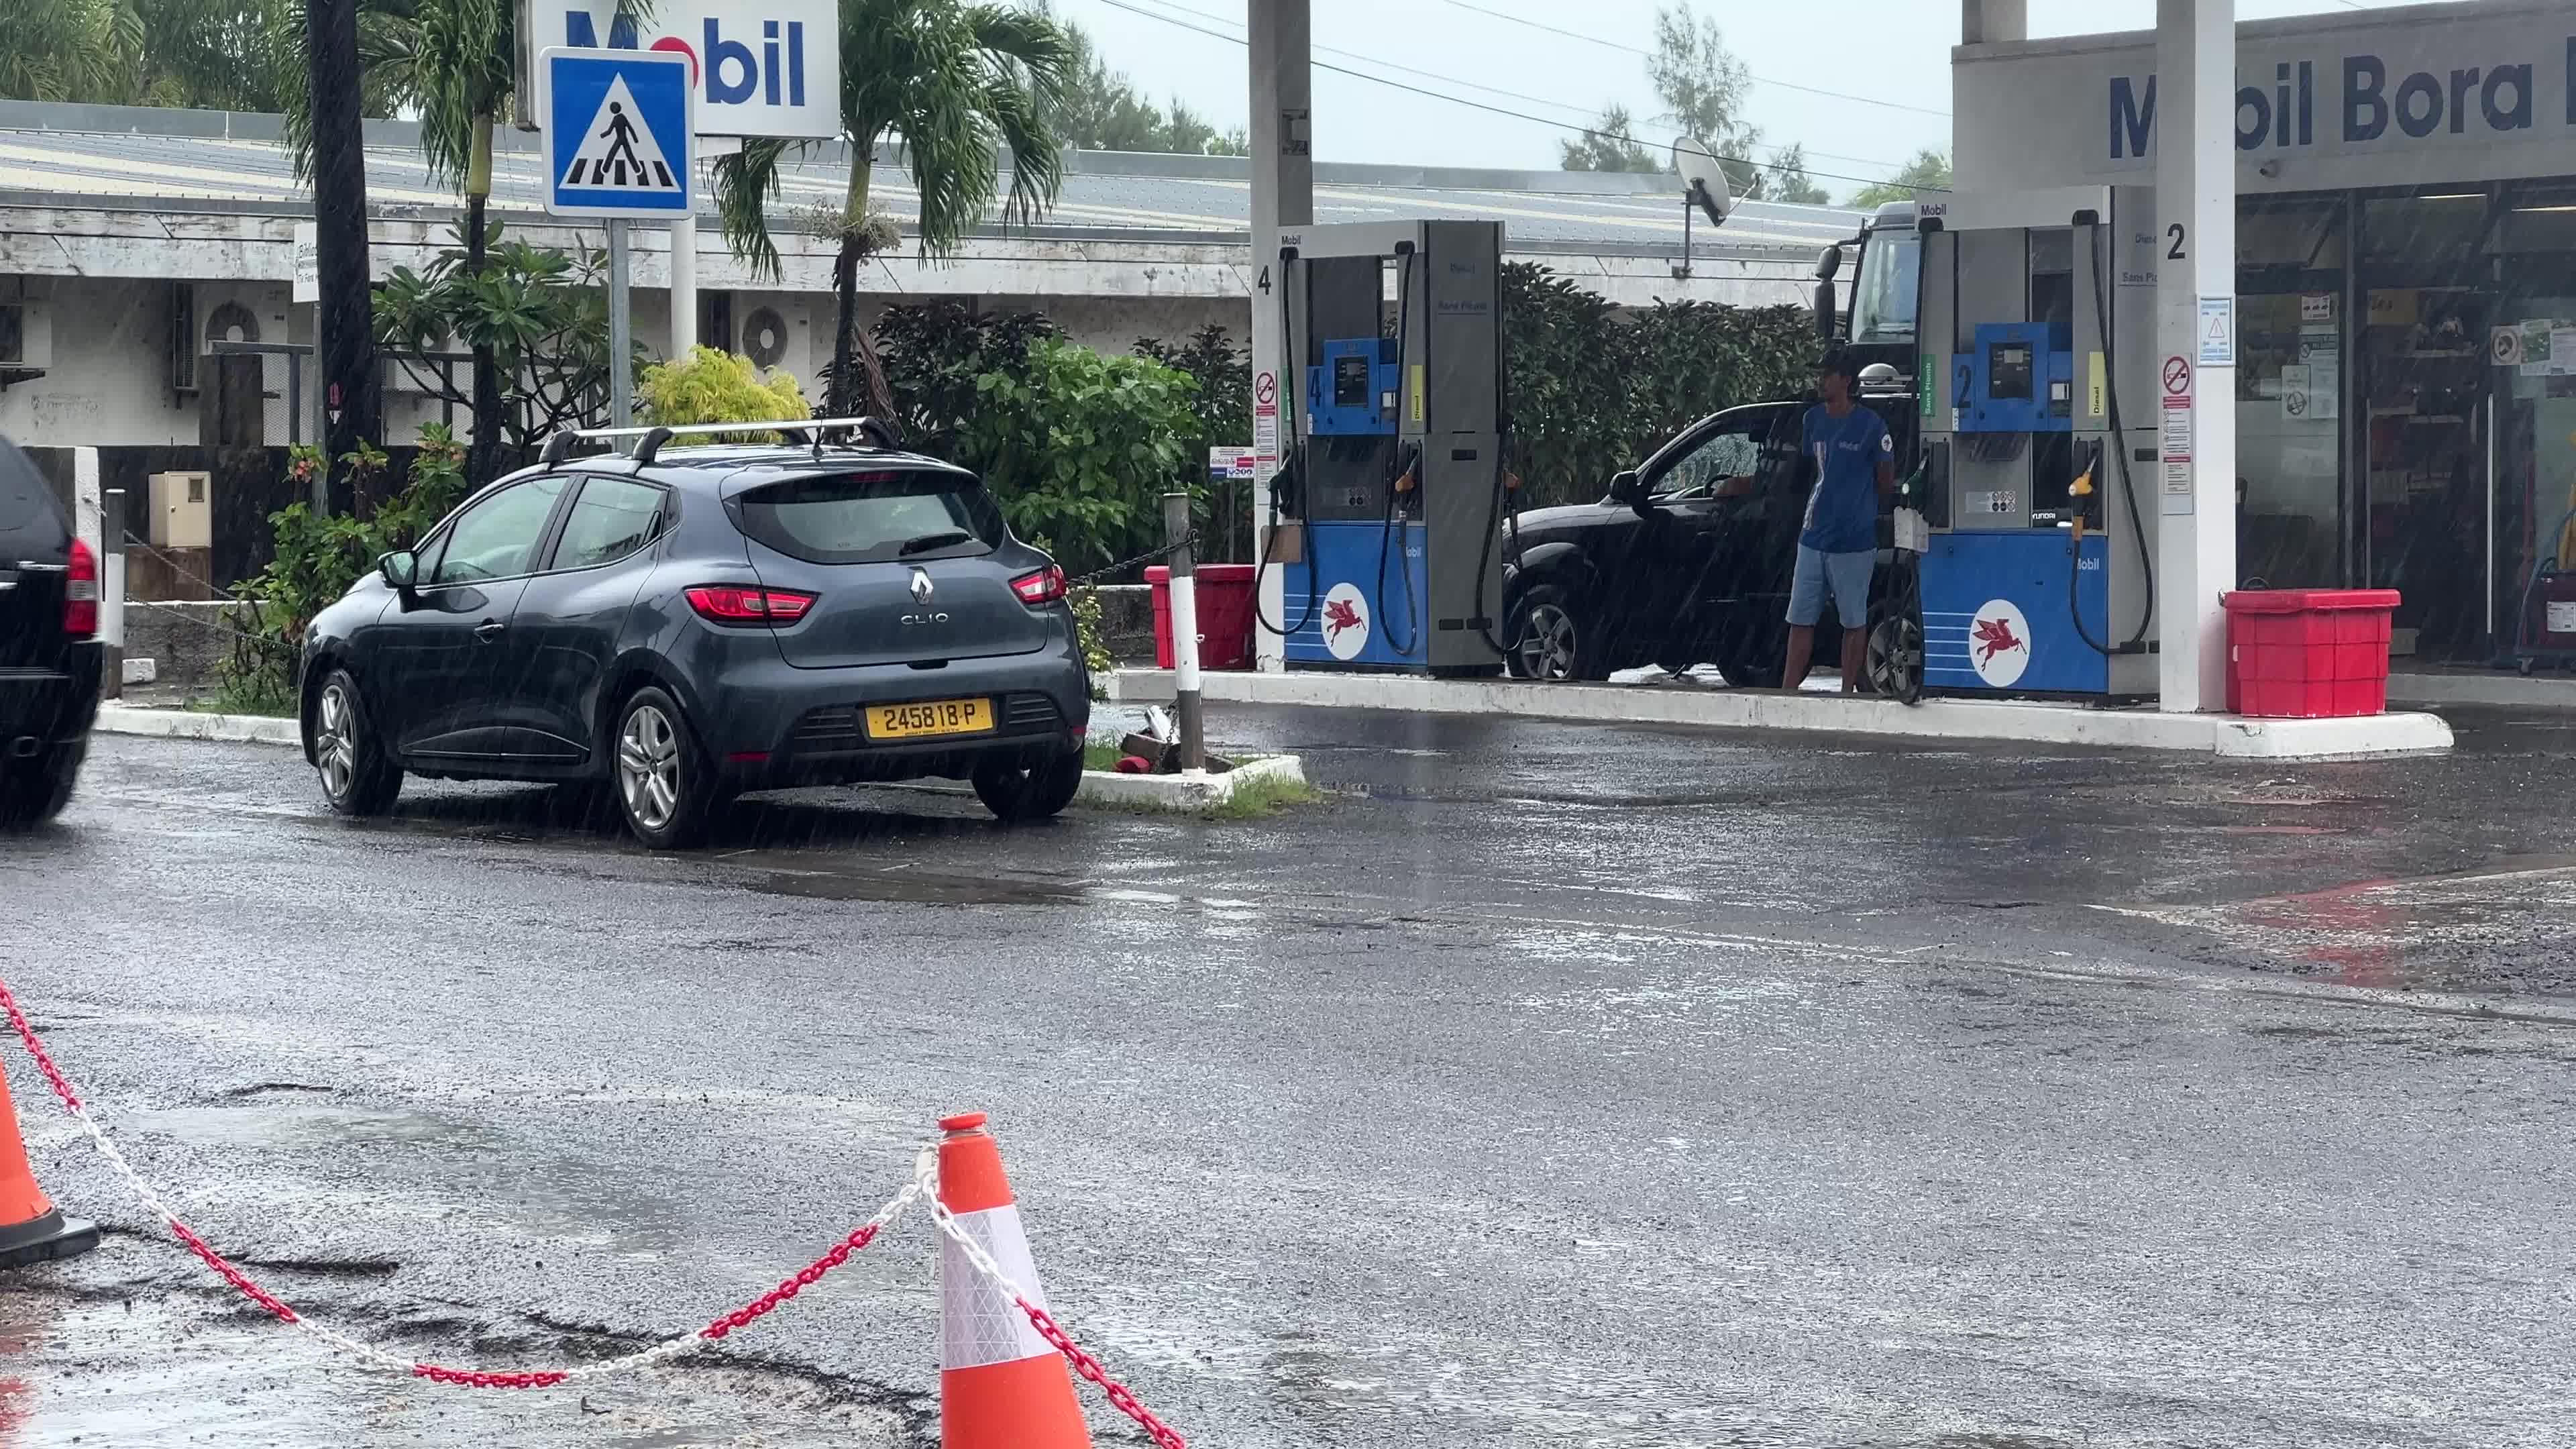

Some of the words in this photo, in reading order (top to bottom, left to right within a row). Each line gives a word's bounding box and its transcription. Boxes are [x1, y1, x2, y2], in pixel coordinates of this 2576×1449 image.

[2110, 60, 2312, 158] Mbil
[2344, 55, 2532, 142] Bora
[1921, 203, 1947, 215] Mobil
[1281, 235, 1301, 246] Mobil
[2167, 223, 2186, 260] 2
[1258, 264, 1271, 295] 4
[1310, 368, 1322, 408] 4
[1957, 364, 1972, 409] 2
[1406, 547, 1421, 558] obil
[901, 612, 949, 625] CLIO
